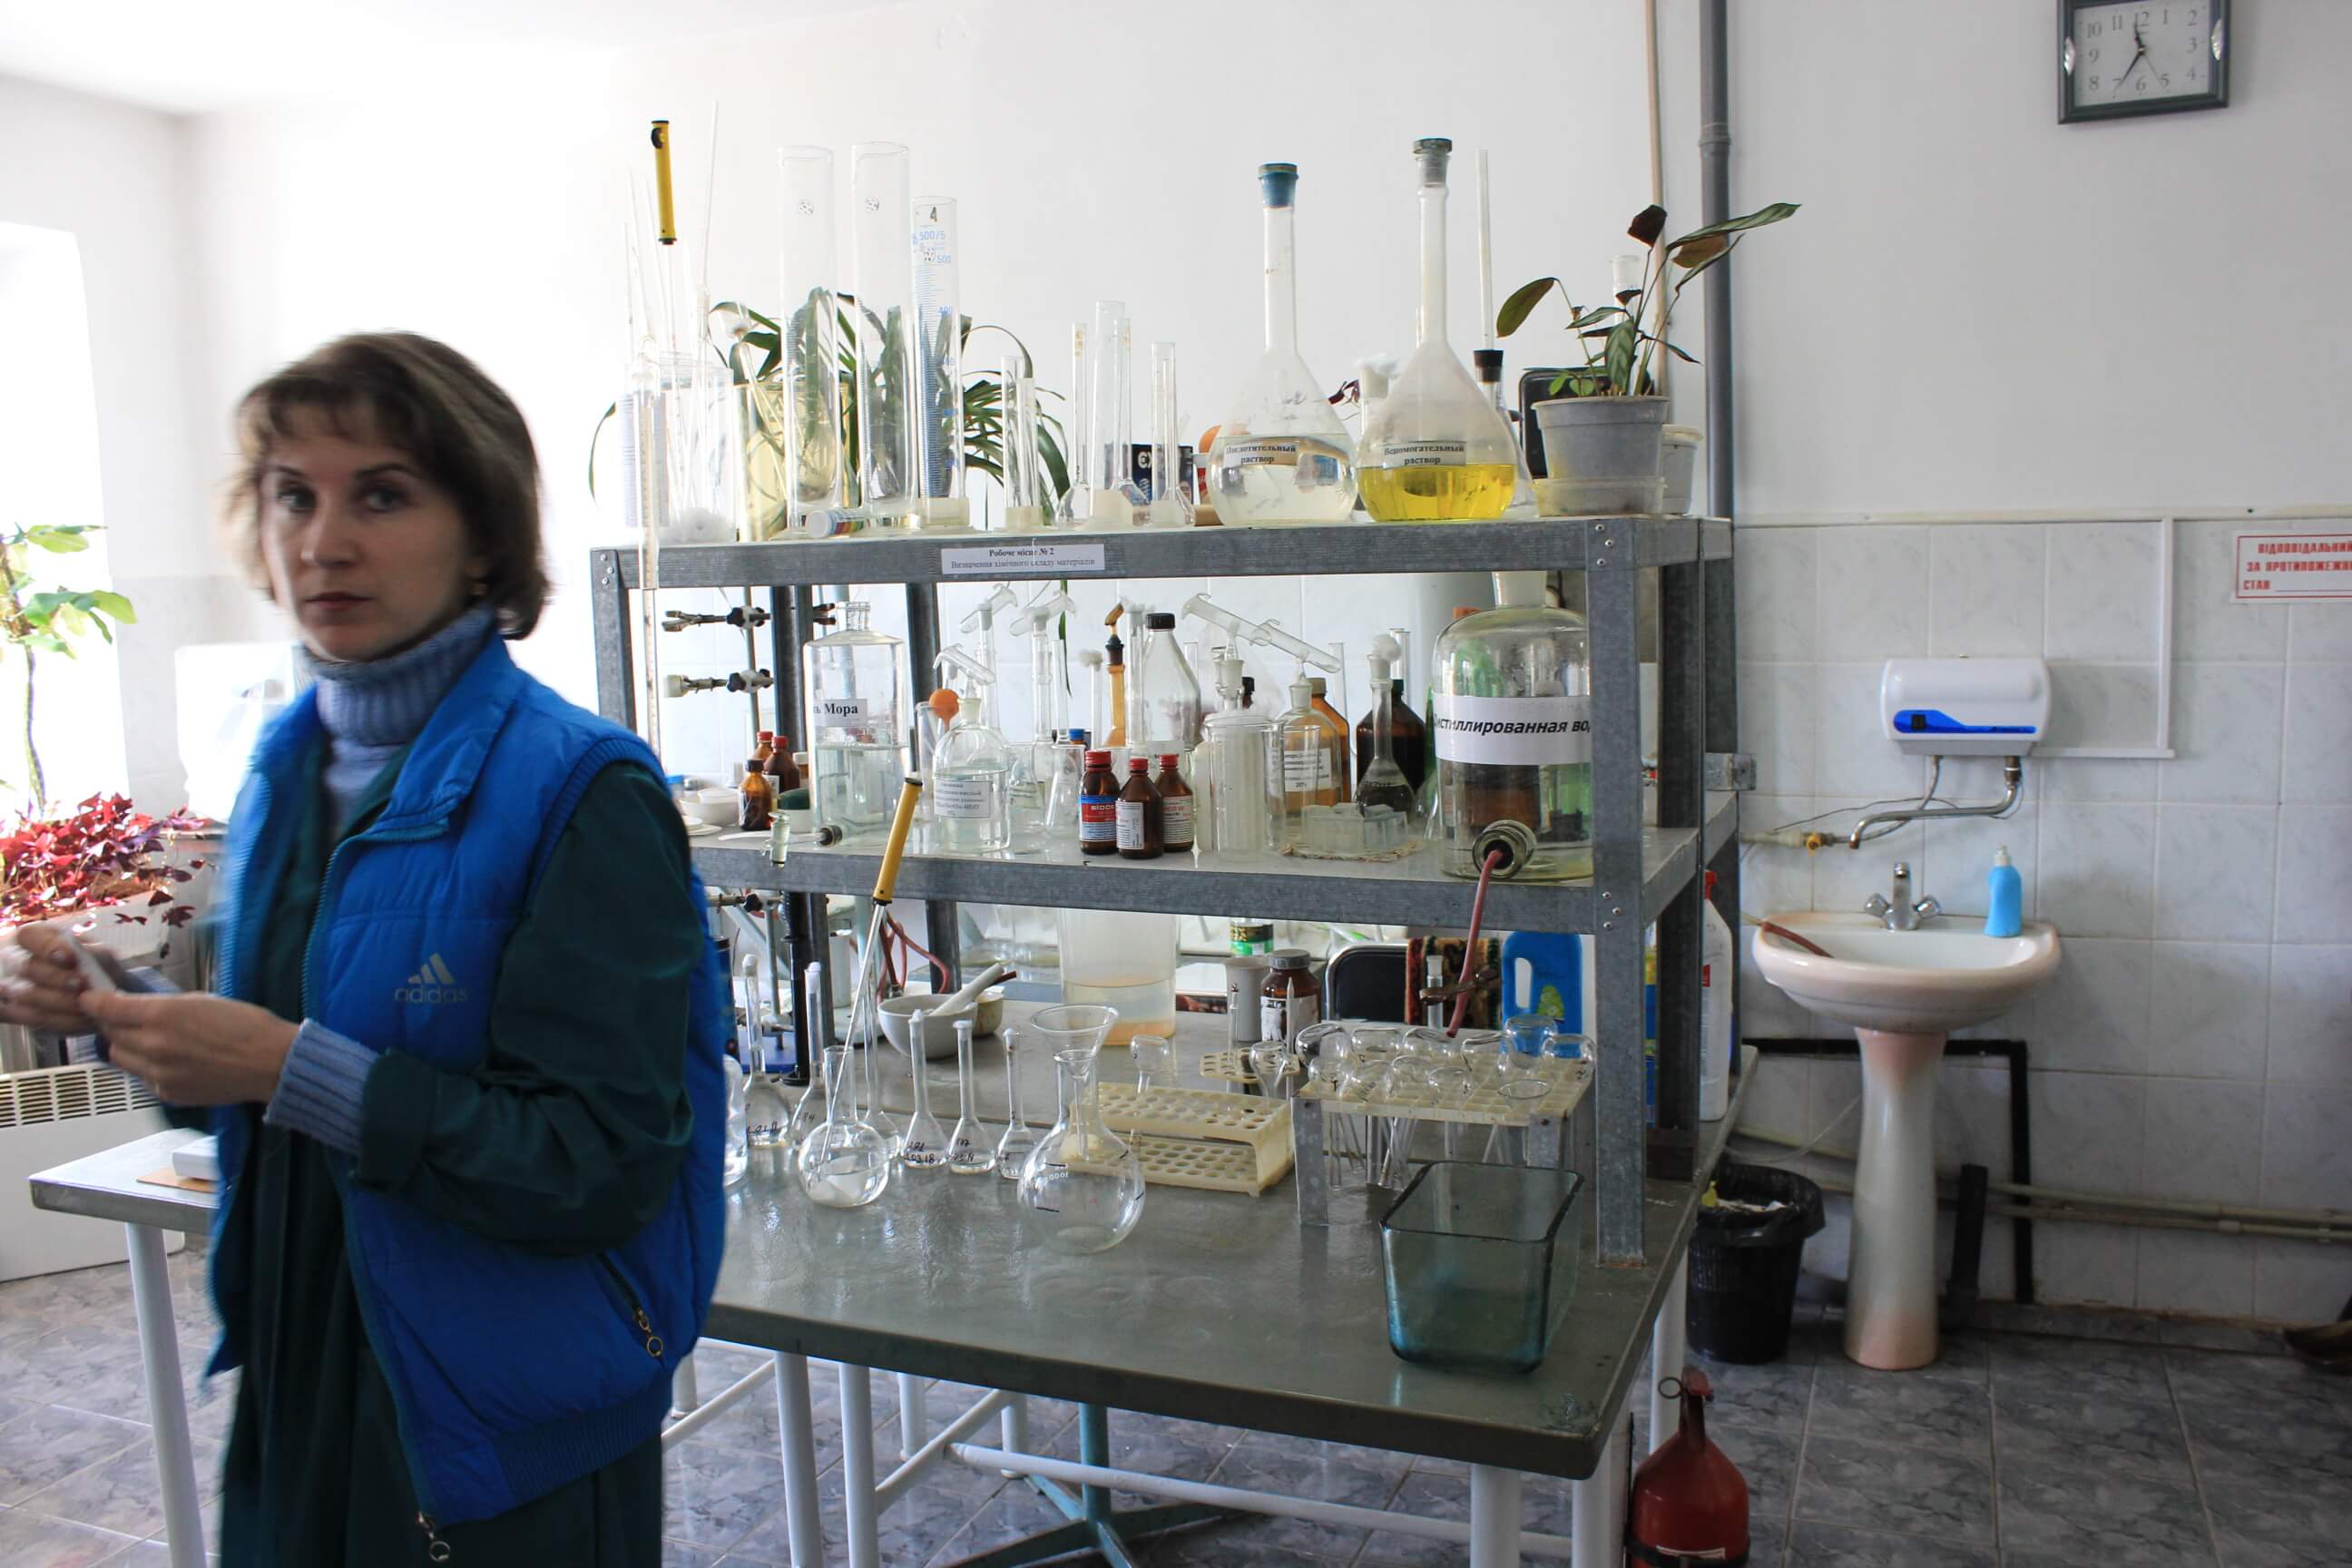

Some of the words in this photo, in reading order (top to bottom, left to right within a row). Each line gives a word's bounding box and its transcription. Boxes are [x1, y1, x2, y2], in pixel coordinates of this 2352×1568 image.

[2112, 15, 2122, 30] 11
[2133, 11, 2150, 28] 12
[2163, 9, 2170, 24] 1
[2187, 9, 2198, 26] 2
[2086, 21, 2102, 38] 10
[2187, 37, 2197, 53] 3
[2088, 49, 2099, 64] 9
[2161, 74, 2170, 88] 5
[2185, 66, 2196, 81] 4
[2088, 75, 2099, 91] 8
[2135, 75, 2146, 92] 6
[1240, 456, 1276, 466] раствор
[1404, 456, 1442, 466] раствор
[989, 548, 1014, 558] Робоче
[1039, 548, 1048, 556] №
[2258, 541, 2352, 554] ВІДПОВІДАЛЬНИЙ
[2247, 562, 2260, 573] ЗА
[2243, 580, 2270, 590] СТАН
[824, 702, 858, 718] Мора
[1435, 713, 1568, 736] истиллированная
[394, 986, 469, 1003] adidas
